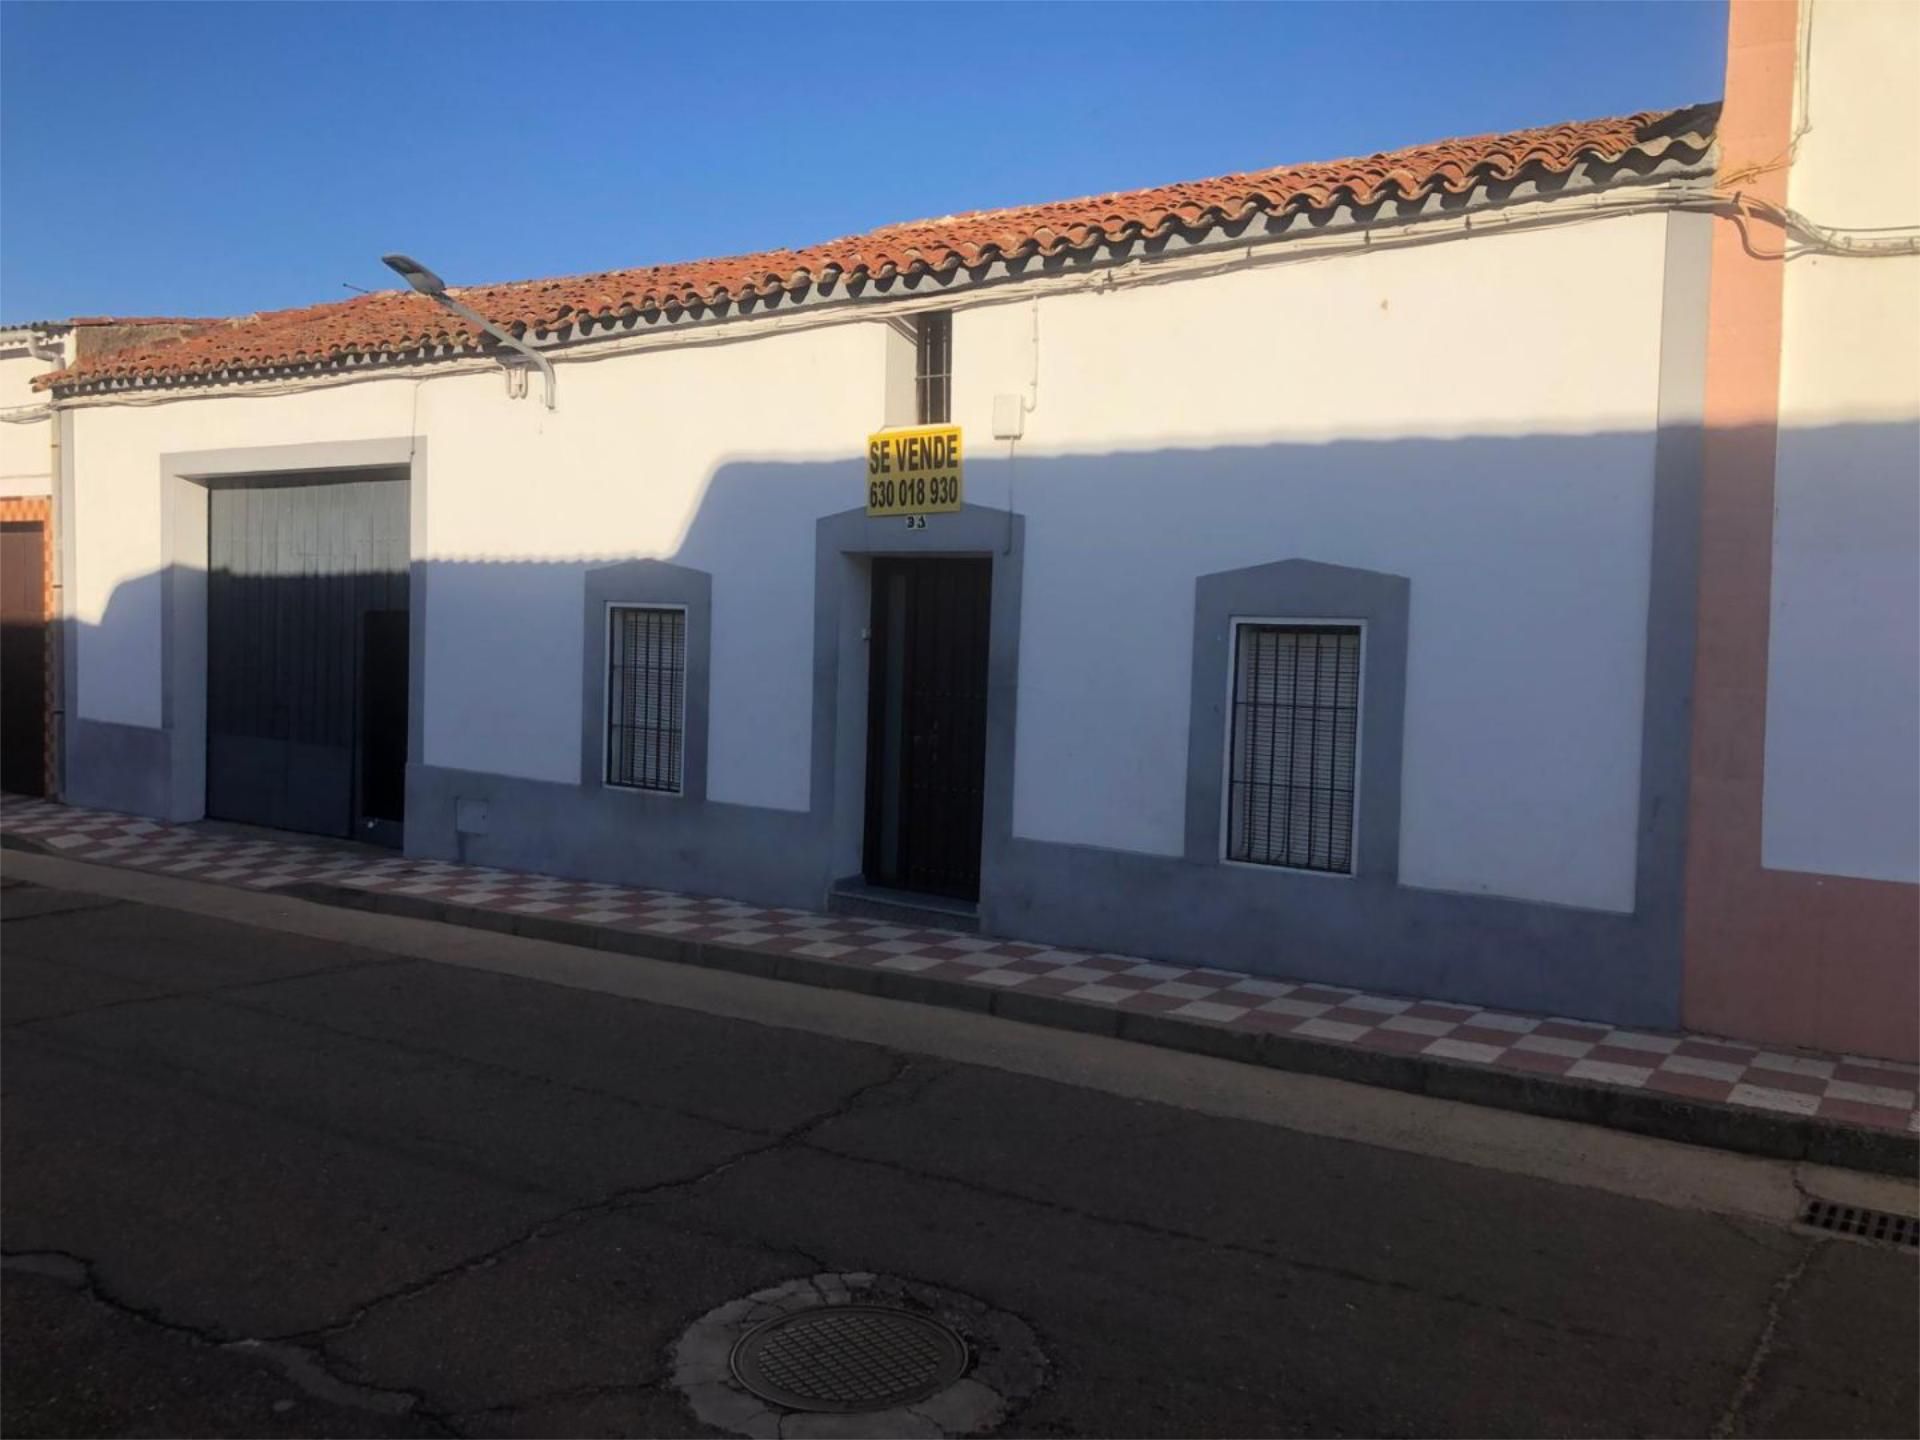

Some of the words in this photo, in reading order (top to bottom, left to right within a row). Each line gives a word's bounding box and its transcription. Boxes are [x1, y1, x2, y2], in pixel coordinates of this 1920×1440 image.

[870, 440, 890, 474] SE
[895, 434, 958, 472] VENDE
[870, 479, 895, 509] 630
[898, 478, 925, 507] 018
[930, 476, 958, 505] 930
